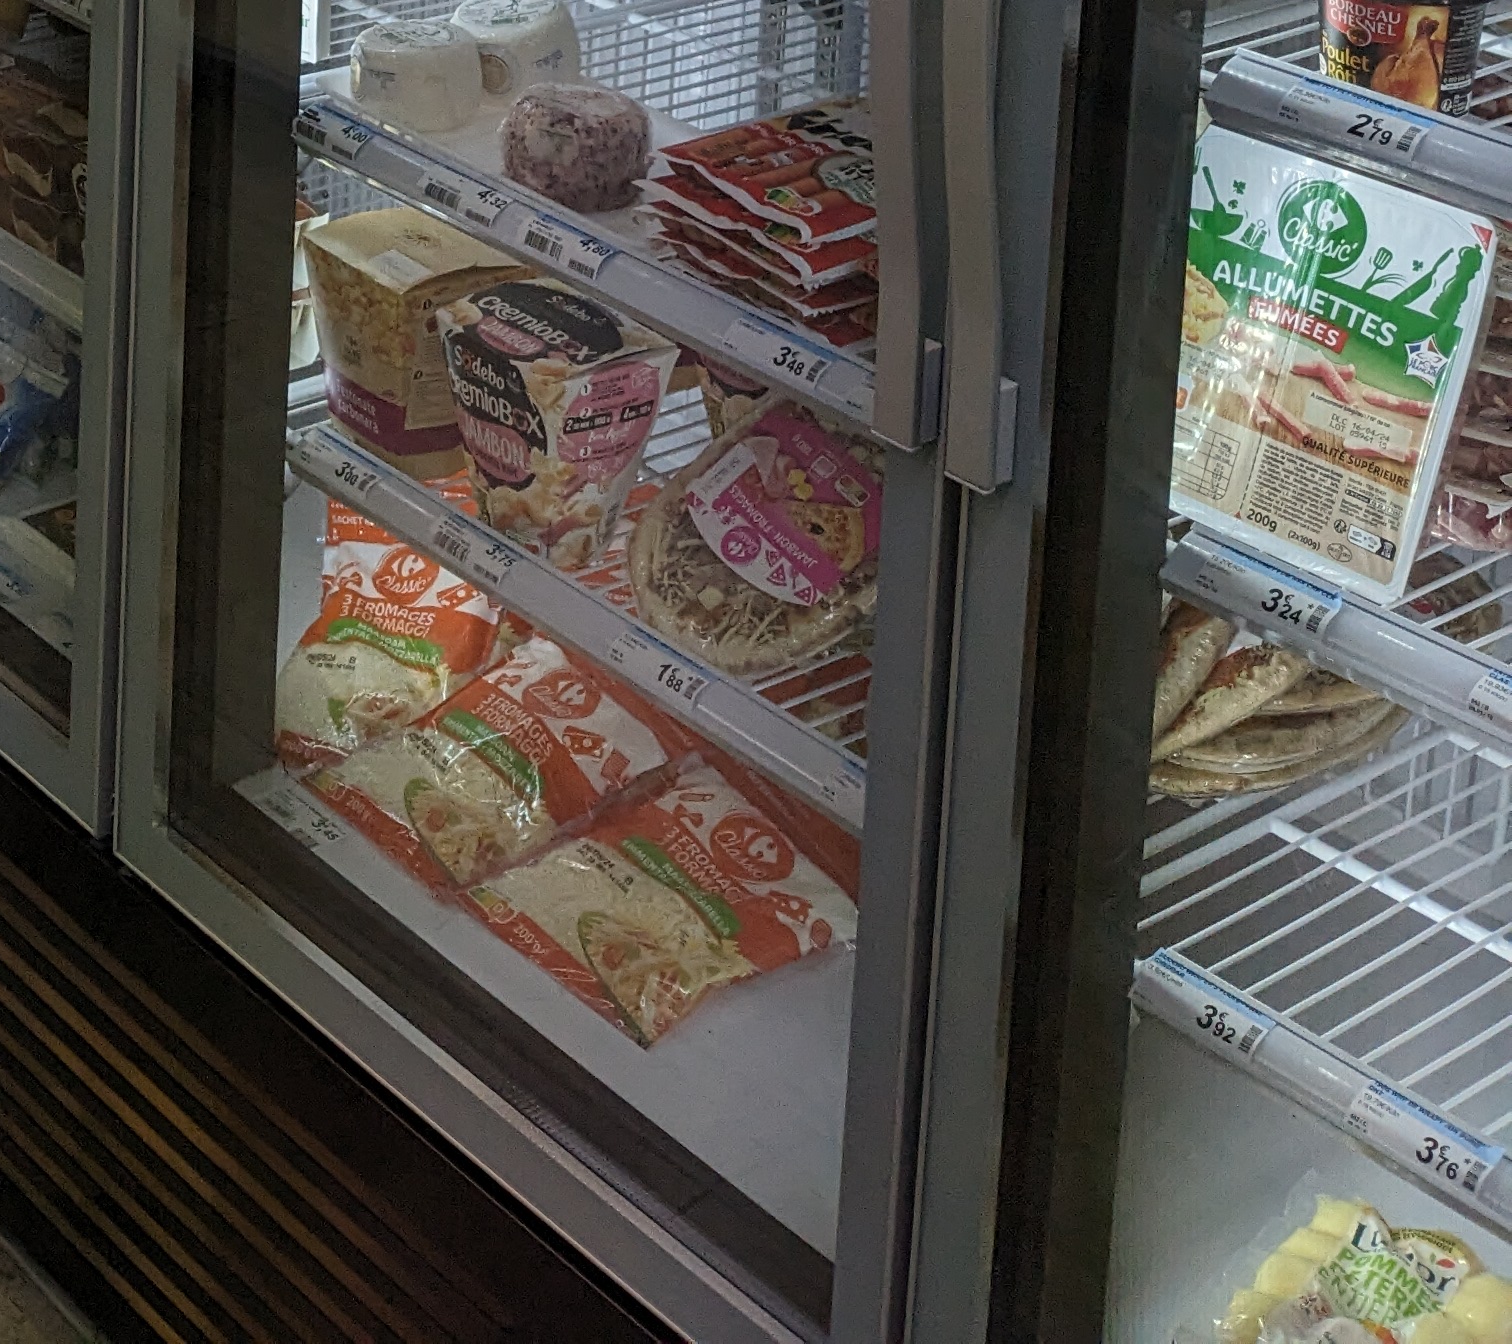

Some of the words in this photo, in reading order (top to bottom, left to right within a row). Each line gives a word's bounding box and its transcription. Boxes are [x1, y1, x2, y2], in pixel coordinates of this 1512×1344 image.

[1331, 9, 1397, 37] CHESNEL
[1322, 37, 1370, 73] Poulet
[1327, 58, 1358, 84] Rôti
[1346, 113, 1393, 146] 2€79
[1212, 260, 1399, 348] ALLUMETTES
[1251, 299, 1341, 348] FUMÉES
[1329, 420, 1346, 433] LOT
[1302, 434, 1348, 464] QUALITÉ
[1347, 454, 1411, 489] SUPÉRIEURE
[1246, 508, 1278, 533] 200g
[1287, 529, 1321, 551] (2x100g)
[339, 605, 349, 617] 3
[352, 607, 430, 638] FORMAGGI
[342, 594, 353, 606] 3
[356, 598, 436, 626] FROMAGES
[1261, 587, 1304, 625] 3€24
[658, 663, 684, 693] 1€88
[491, 697, 553, 758] FROMAGES
[1196, 1004, 1237, 1044] 3€92
[1415, 1136, 1460, 1180] 3€76
